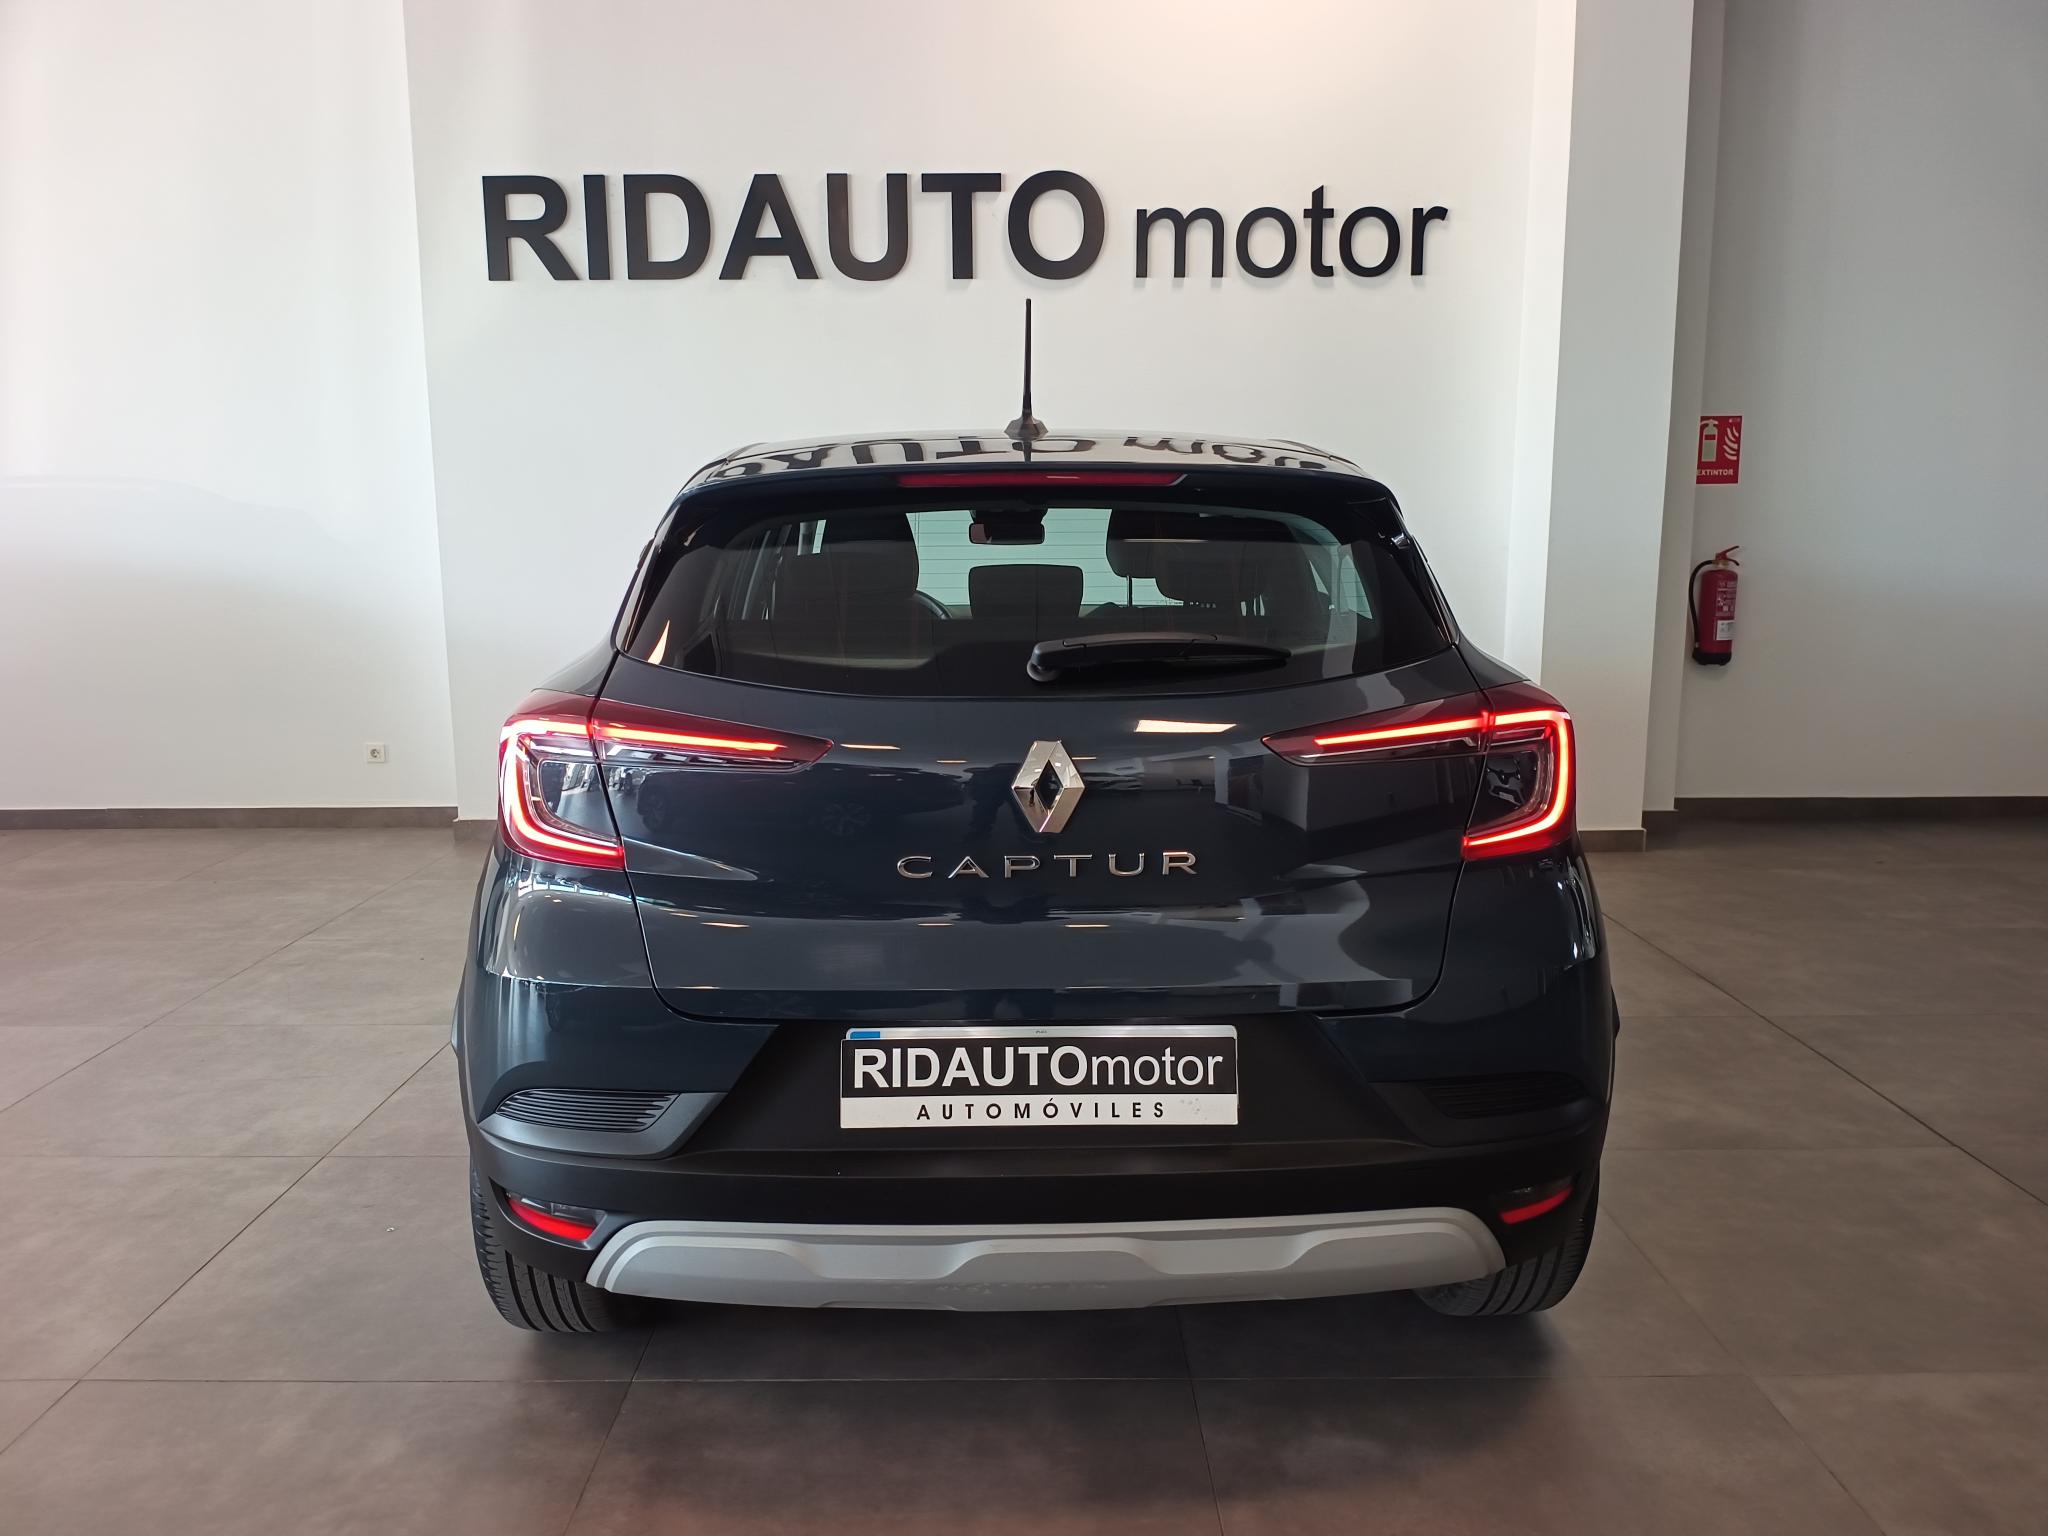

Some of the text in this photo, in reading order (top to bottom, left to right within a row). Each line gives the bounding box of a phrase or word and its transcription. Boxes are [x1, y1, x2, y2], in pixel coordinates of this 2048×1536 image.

[481, 170, 1449, 282] RIDAUTO motor
[1696, 468, 1734, 477] EXTINTOR
[897, 851, 1197, 879] CAPTUR
[853, 1045, 1224, 1088] RIDAUTOmotor
[916, 1097, 1165, 1121] AUTOMÓVILES
